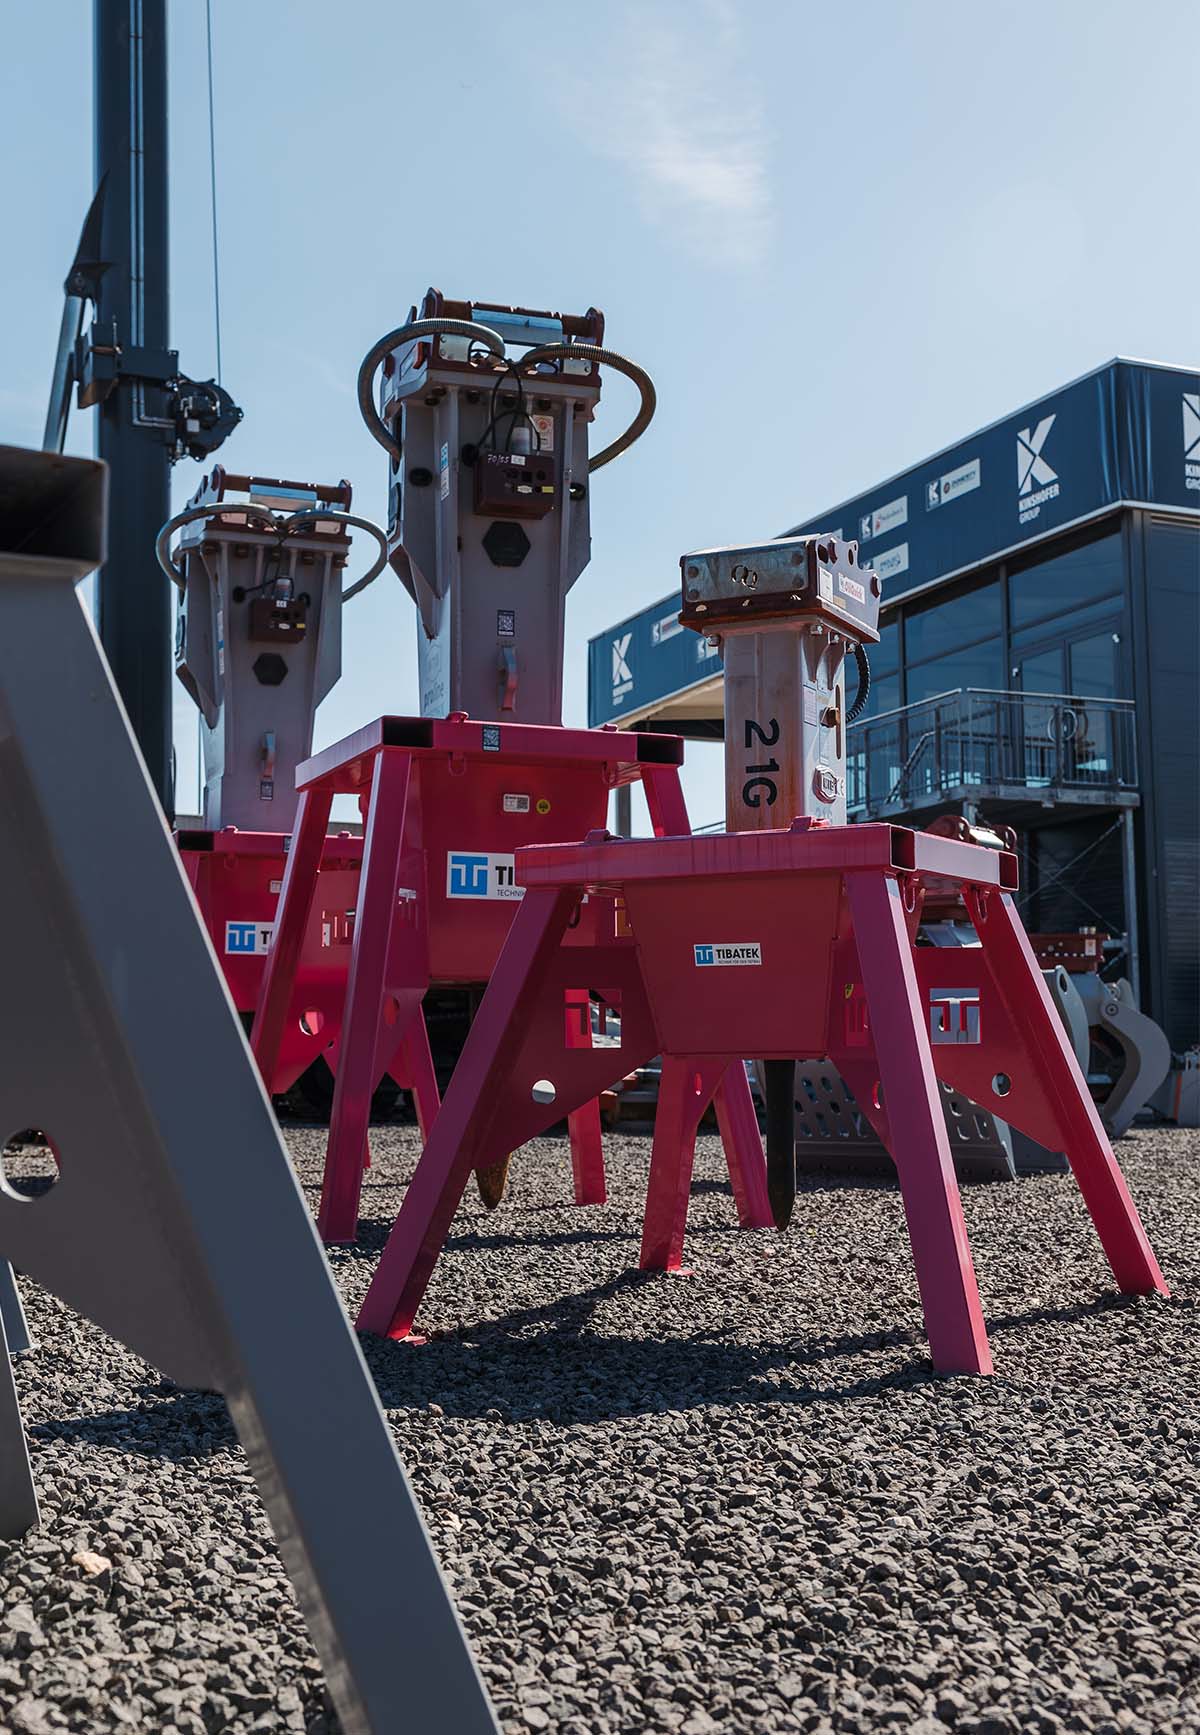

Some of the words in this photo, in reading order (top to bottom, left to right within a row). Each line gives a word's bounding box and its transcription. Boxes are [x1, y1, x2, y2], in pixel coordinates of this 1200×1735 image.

[1018, 483, 1060, 513] KINSHOFER
[1018, 506, 1041, 525] GROUP
[742, 718, 780, 808] 21G
[716, 948, 760, 959] TIBATEK
